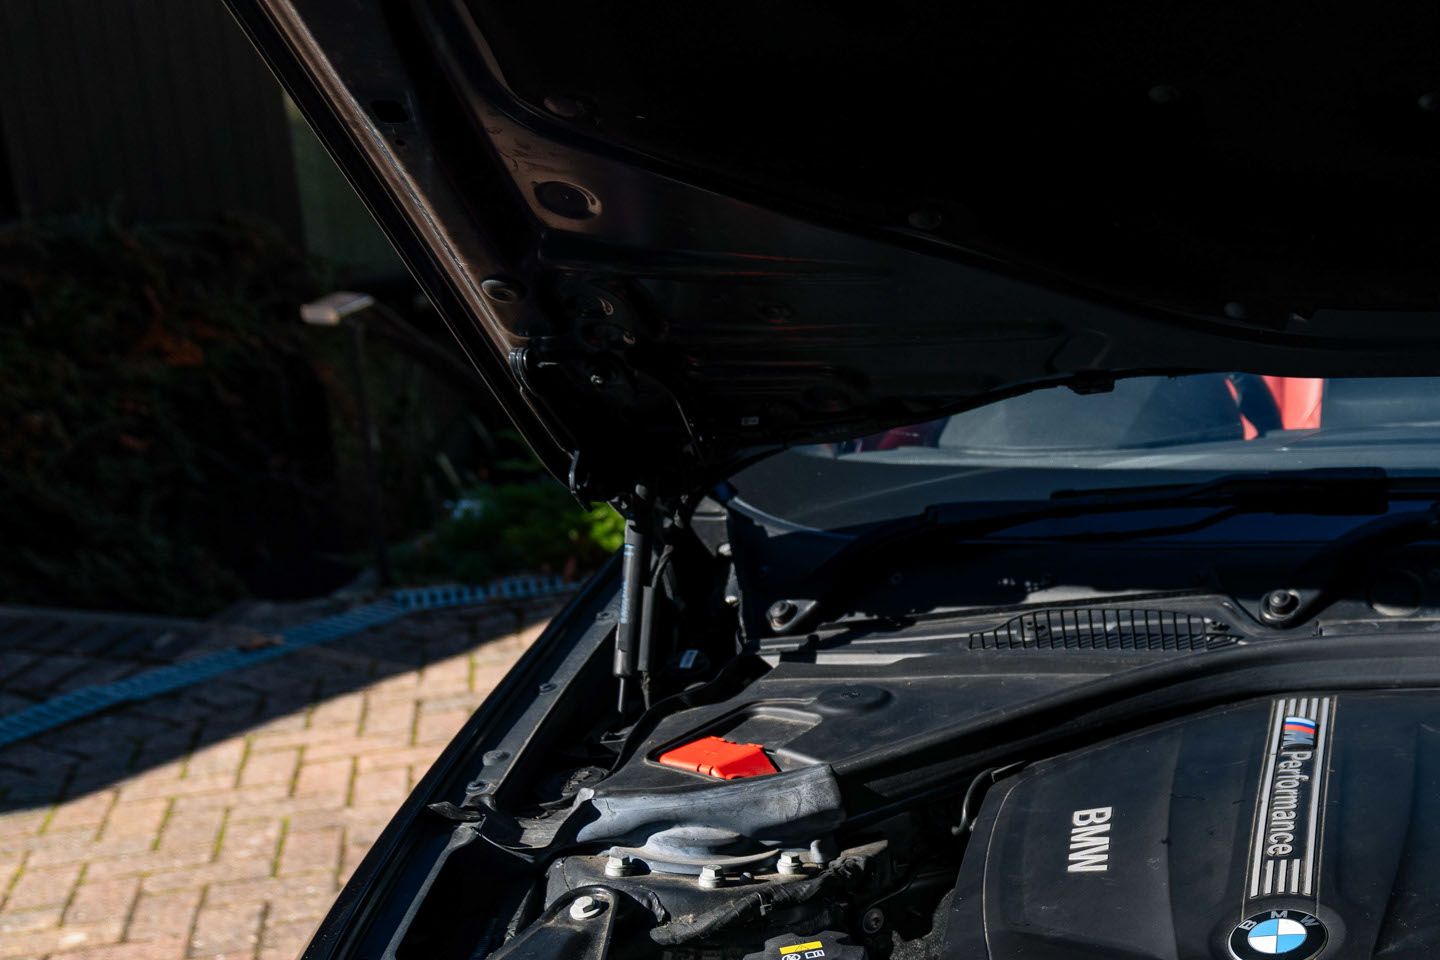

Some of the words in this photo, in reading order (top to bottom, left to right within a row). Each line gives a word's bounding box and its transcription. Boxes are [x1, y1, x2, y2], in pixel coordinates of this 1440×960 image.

[1266, 751, 1312, 857] Performance
[1067, 806, 1113, 873] BMW
[1239, 910, 1320, 930] BMW
